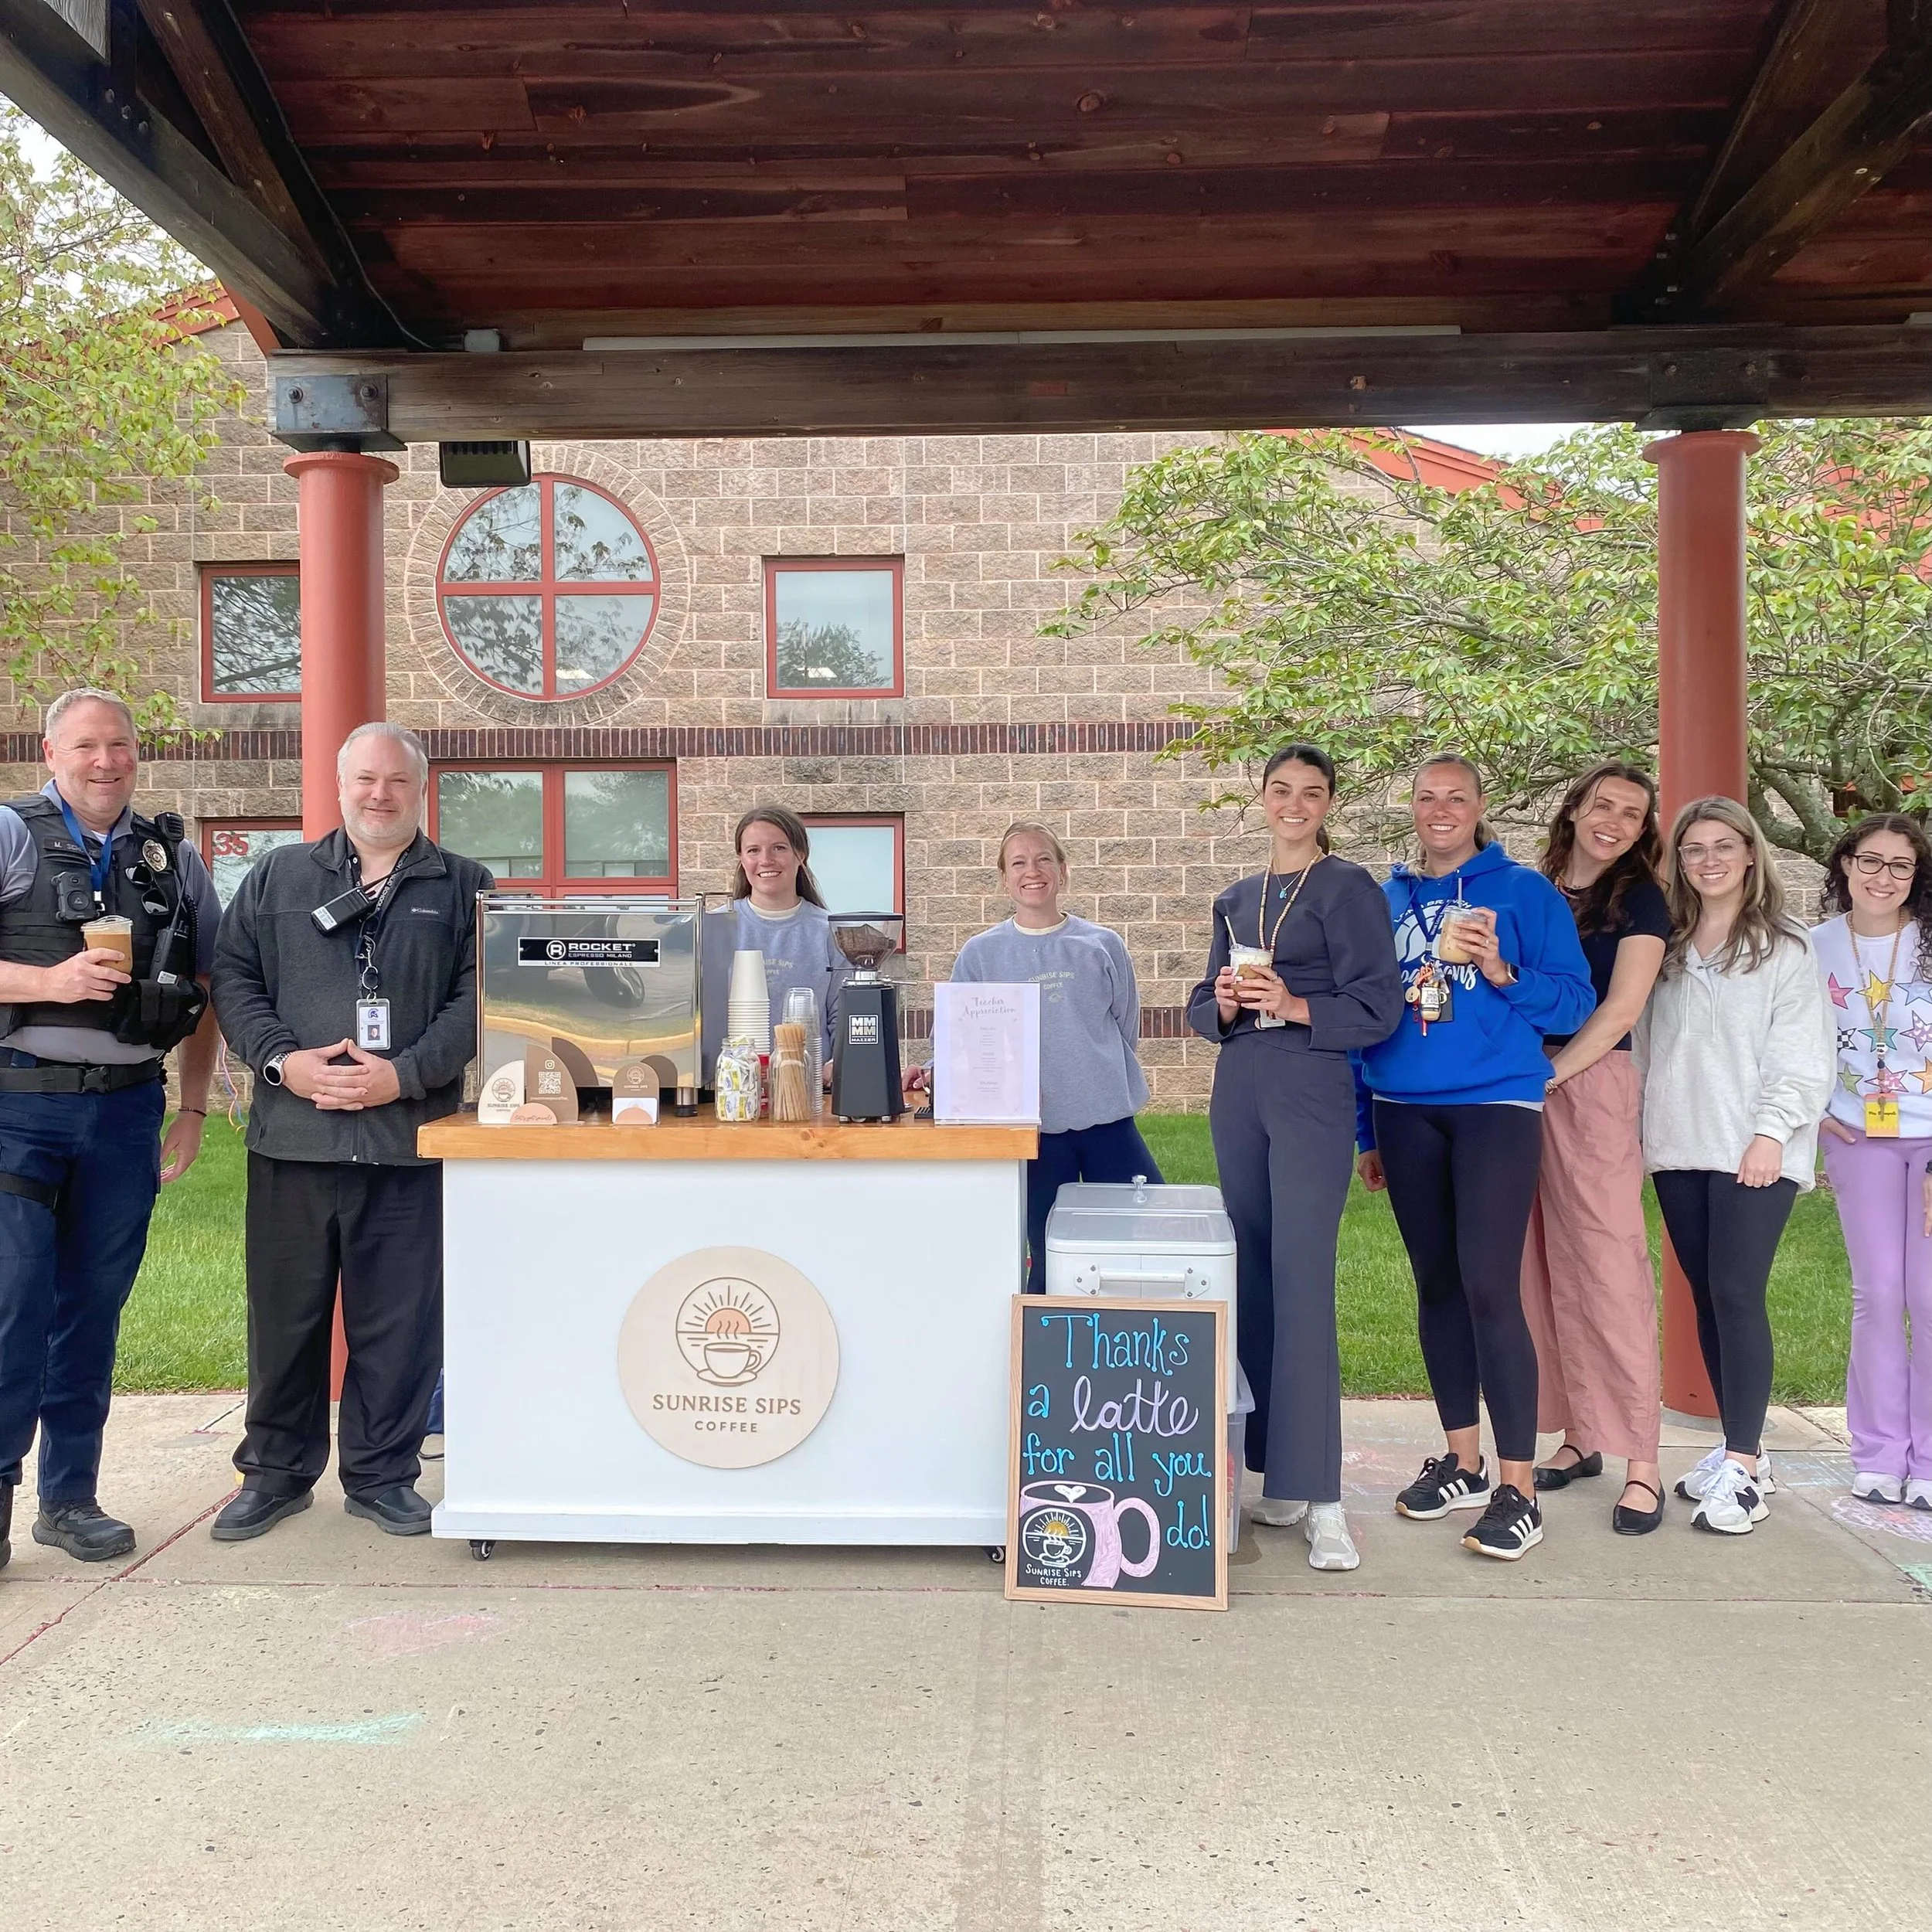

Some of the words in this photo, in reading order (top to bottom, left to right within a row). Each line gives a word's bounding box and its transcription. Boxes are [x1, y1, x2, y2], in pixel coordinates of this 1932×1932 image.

[216, 832, 249, 855] 35
[1059, 971, 1075, 979] SIPS
[962, 1005, 1016, 1019] Appreciation
[971, 996, 1005, 1006] Teacher
[1041, 1312, 1190, 1376] Thanks
[652, 1394, 748, 1413] SUNRISE
[755, 1398, 801, 1416] SIPS
[1027, 1383, 1049, 1418] a
[1070, 1375, 1199, 1437] latte
[694, 1420, 759, 1433] COFFEE
[1022, 1433, 1075, 1475] for
[1094, 1431, 1136, 1482] all
[1151, 1451, 1213, 1498] you
[1165, 1494, 1212, 1549] do!
